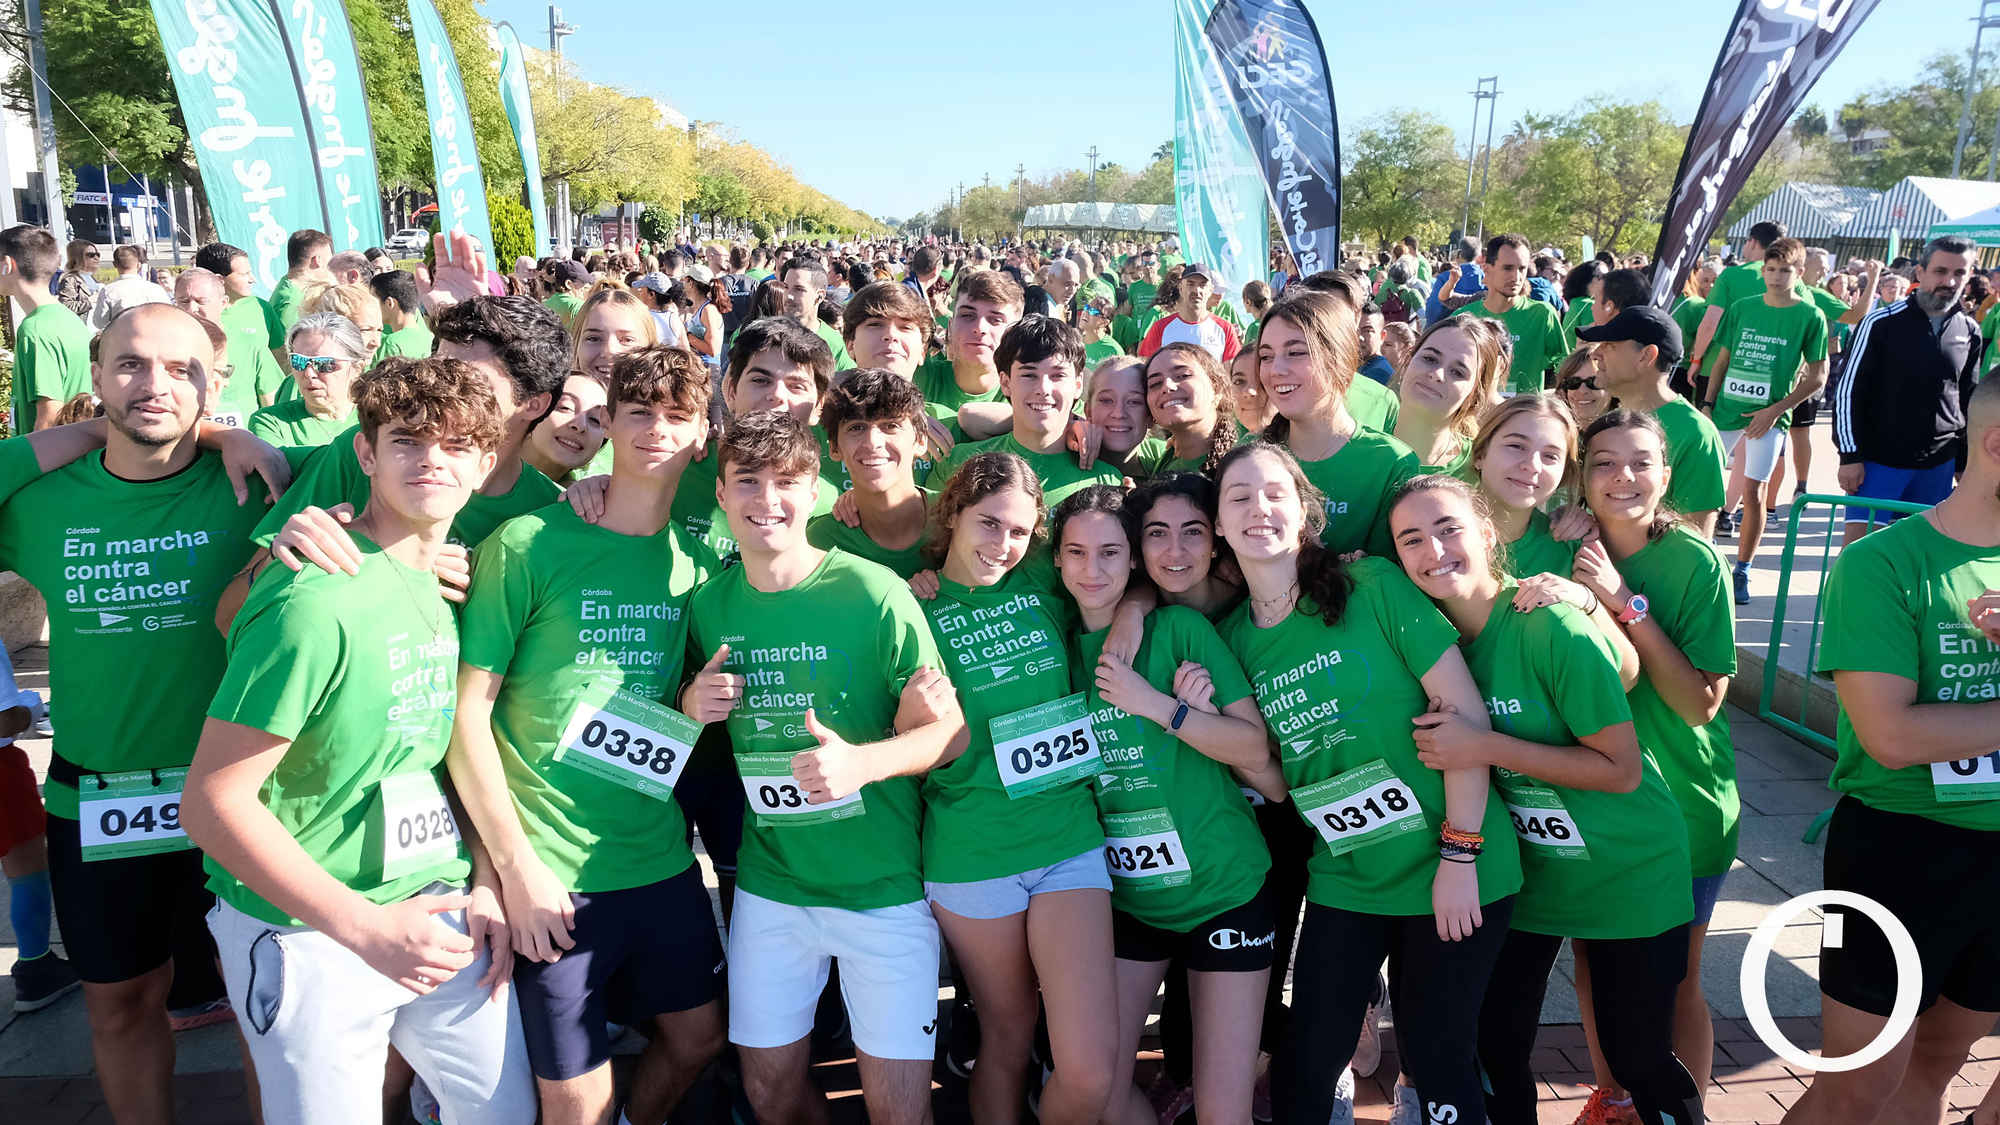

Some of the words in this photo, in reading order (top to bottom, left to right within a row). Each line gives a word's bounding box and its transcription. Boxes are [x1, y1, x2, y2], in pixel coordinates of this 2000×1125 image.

[76, 194, 100, 202] FIATC
[1738, 341, 1767, 351] contra
[1741, 331, 1754, 340] En
[1754, 334, 1788, 346] marcha
[1735, 348, 1745, 357] el
[1745, 350, 1777, 361] cáncer
[1729, 381, 1766, 396] 0440
[65, 527, 101, 535] Córdoba
[63, 538, 96, 558] En
[106, 530, 210, 556] marcha
[64, 560, 150, 581] contra
[65, 584, 87, 604] el
[94, 578, 192, 603] cáncer
[581, 588, 613, 596] Córdoba
[580, 600, 610, 620] En
[617, 601, 682, 621] marcha
[932, 602, 961, 617] Córdoba
[936, 613, 968, 634] En
[971, 594, 1041, 623] marcha
[578, 624, 646, 643] contra
[720, 635, 745, 643] Córdoba
[949, 620, 1016, 649] contra
[1938, 633, 1978, 655] En
[575, 647, 597, 665] el
[602, 646, 665, 666] cáncer
[750, 641, 828, 664] marcha
[958, 648, 978, 666] el
[981, 629, 1049, 660] cáncer
[388, 647, 411, 671] En
[1272, 649, 1342, 691] marcha
[972, 673, 1020, 693] Responsablemente
[1937, 681, 1962, 700] el
[749, 689, 816, 709] cáncer
[618, 693, 628, 702] En
[627, 696, 650, 711] Marcha
[650, 705, 671, 719] Contra
[670, 714, 678, 722] el
[677, 717, 700, 731] Cáncer
[993, 717, 1018, 728] Córdoba
[1017, 714, 1026, 722] En
[1025, 709, 1045, 720] Marcha
[1045, 704, 1063, 714] Contra
[1067, 697, 1084, 707] Cáncer
[1278, 698, 1340, 735] cáncer
[581, 720, 676, 775] 0338
[1011, 728, 1090, 775] 0325
[1102, 745, 1144, 763] áncer
[159, 771, 185, 779] Contra
[1294, 789, 1315, 799] Córdoba
[1321, 780, 1341, 791] Marcha
[1340, 772, 1360, 783] Contra
[1364, 763, 1384, 773] Cáncer
[759, 784, 806, 809] 03
[100, 803, 183, 836] 049
[1124, 816, 1142, 824] Contra
[1141, 814, 1148, 822] el
[1147, 812, 1168, 821] Cáncer
[1323, 787, 1409, 832] 0318
[397, 807, 454, 849] 0328
[1509, 810, 1571, 840] 346
[1106, 842, 1175, 872] 0321
